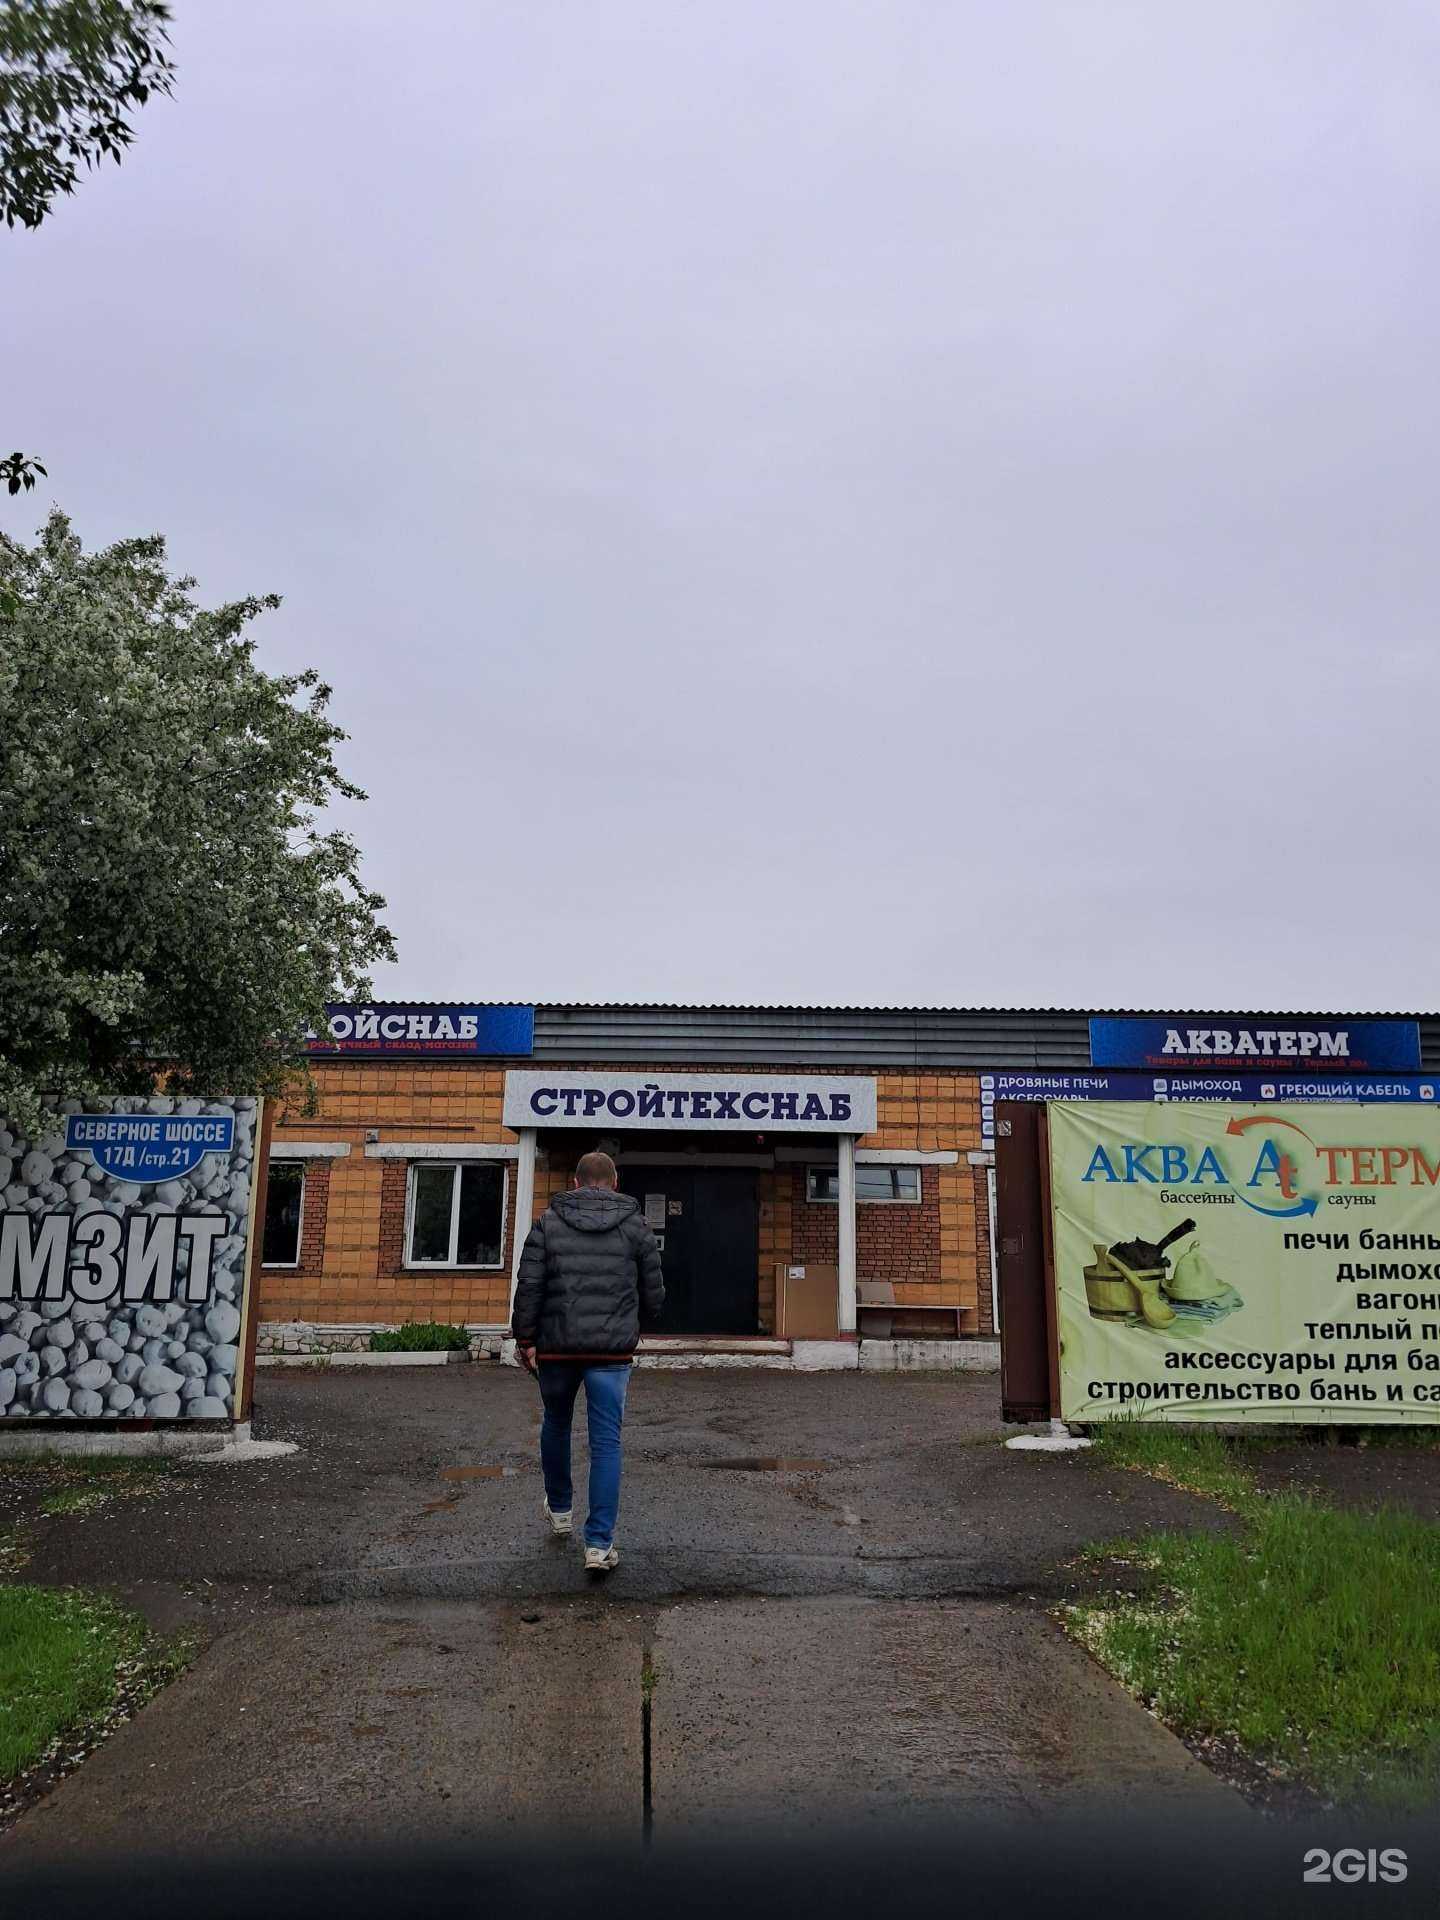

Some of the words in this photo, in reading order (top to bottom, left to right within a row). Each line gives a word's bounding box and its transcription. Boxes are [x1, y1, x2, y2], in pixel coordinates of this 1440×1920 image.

[1162, 1029, 1350, 1056] АКВАТЕРМ
[998, 1077, 1070, 1089] ДРОВЯНЫЕ
[1073, 1079, 1109, 1089] ПЕЧИ
[1171, 1080, 1242, 1092] ДЫМОХОД
[1279, 1081, 1353, 1097] ГРЕЮЩИЙ
[1356, 1085, 1411, 1096] КАБЕЛЬ
[530, 1084, 851, 1121] СТРОЙТЕХСНАБ
[74, 1122, 160, 1141] СЕВЕРНОЕ
[104, 1147, 135, 1167] 17Д
[1081, 1144, 1230, 1184] АКВА
[1160, 1189, 1235, 1205] бассейны
[1327, 1193, 1376, 1206] сауны
[1283, 1233, 1349, 1250] печи
[1304, 1318, 1412, 1340] теплый
[1164, 1352, 1335, 1373] аксессуары
[1344, 1353, 1397, 1373] для
[1087, 1381, 1300, 1403] строительство
[1310, 1379, 1377, 1401] бань
[1386, 1384, 1403, 1401] и
